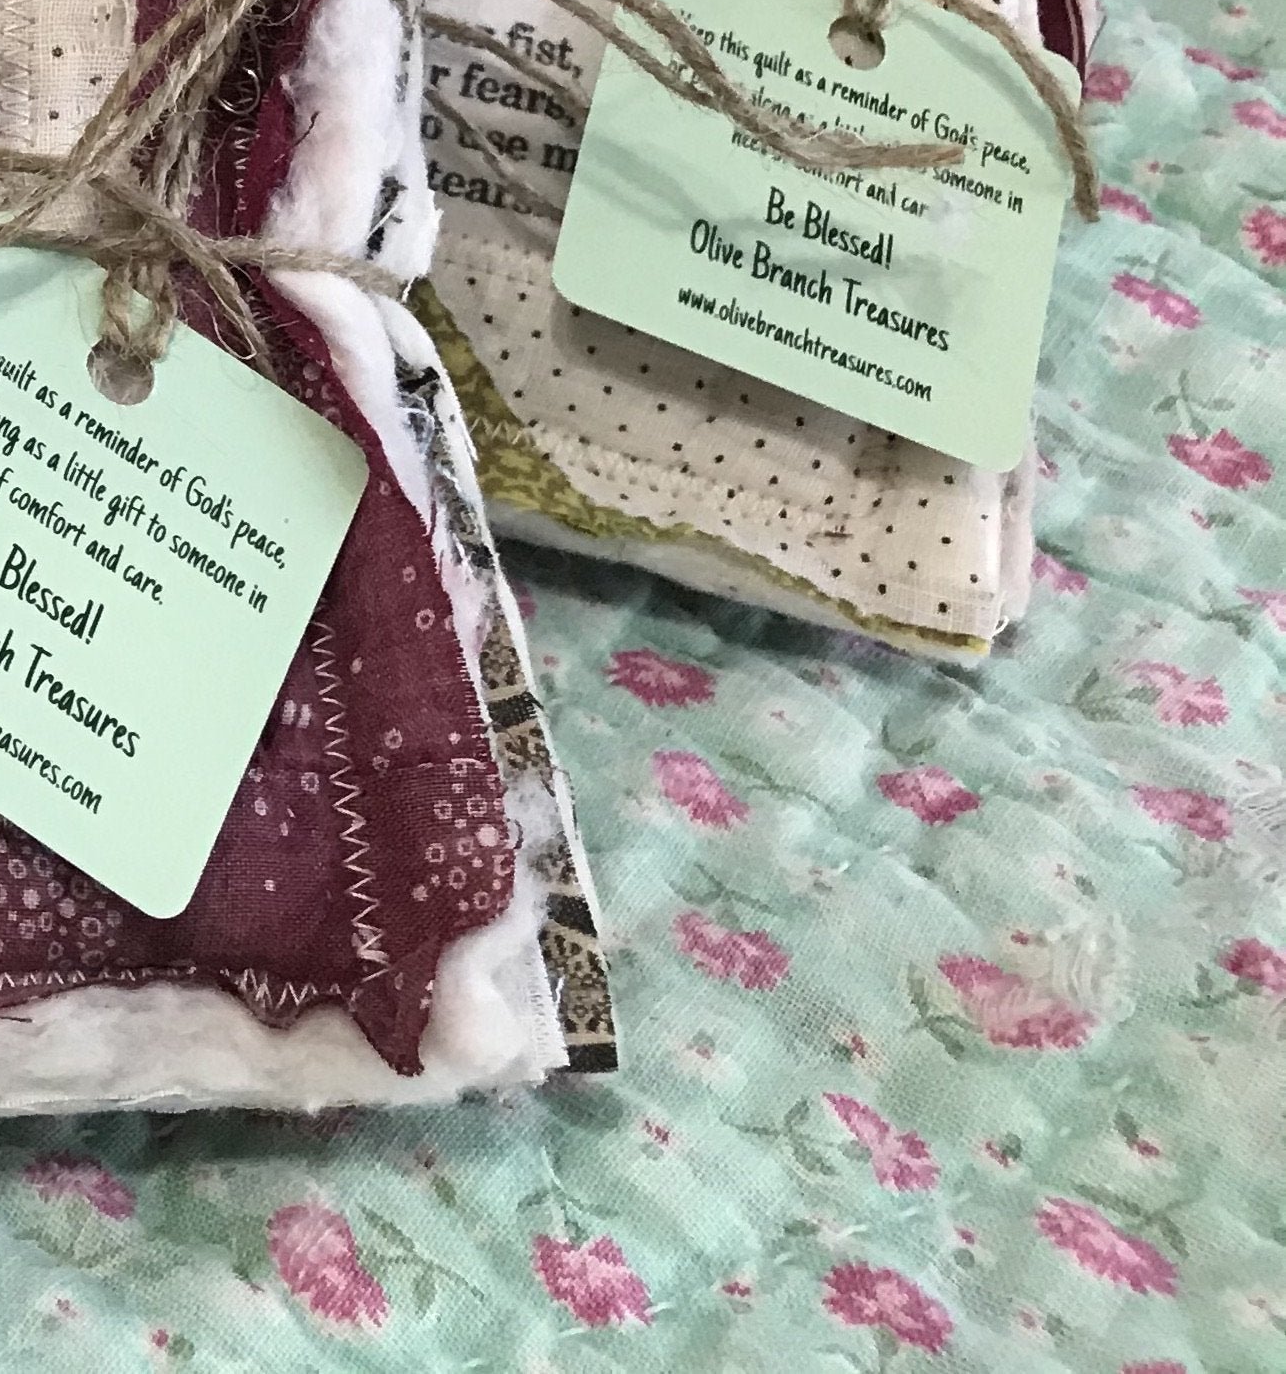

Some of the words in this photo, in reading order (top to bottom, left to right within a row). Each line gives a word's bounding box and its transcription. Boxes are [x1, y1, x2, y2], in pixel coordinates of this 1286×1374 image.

[720, 31, 749, 61] this
[795, 68, 813, 86] as
[817, 77, 826, 91] a
[831, 81, 907, 121] reminder
[911, 108, 930, 132] of
[765, 186, 795, 230] Be
[803, 200, 893, 270] Blessed!
[933, 167, 1002, 204] someone
[1008, 191, 1023, 213] in
[690, 219, 743, 269] Olive
[751, 240, 832, 304] Branch
[843, 278, 949, 351] Treasures
[678, 287, 931, 402] www.olivebranchtreasures.com
[23, 437, 46, 460] as
[47, 454, 60, 471] a
[64, 451, 107, 501] little
[104, 495, 146, 526] gift
[147, 513, 166, 542] to
[169, 535, 245, 597] someone
[248, 585, 268, 613] in
[35, 386, 58, 408] as
[59, 402, 72, 419] a
[74, 411, 159, 474] reminder
[160, 467, 187, 492] of
[186, 476, 234, 528] God's
[230, 519, 285, 569] peace,
[9, 486, 87, 547] comfort
[85, 544, 124, 573] and
[123, 565, 163, 605] care.
[25, 644, 140, 757] Treasures
